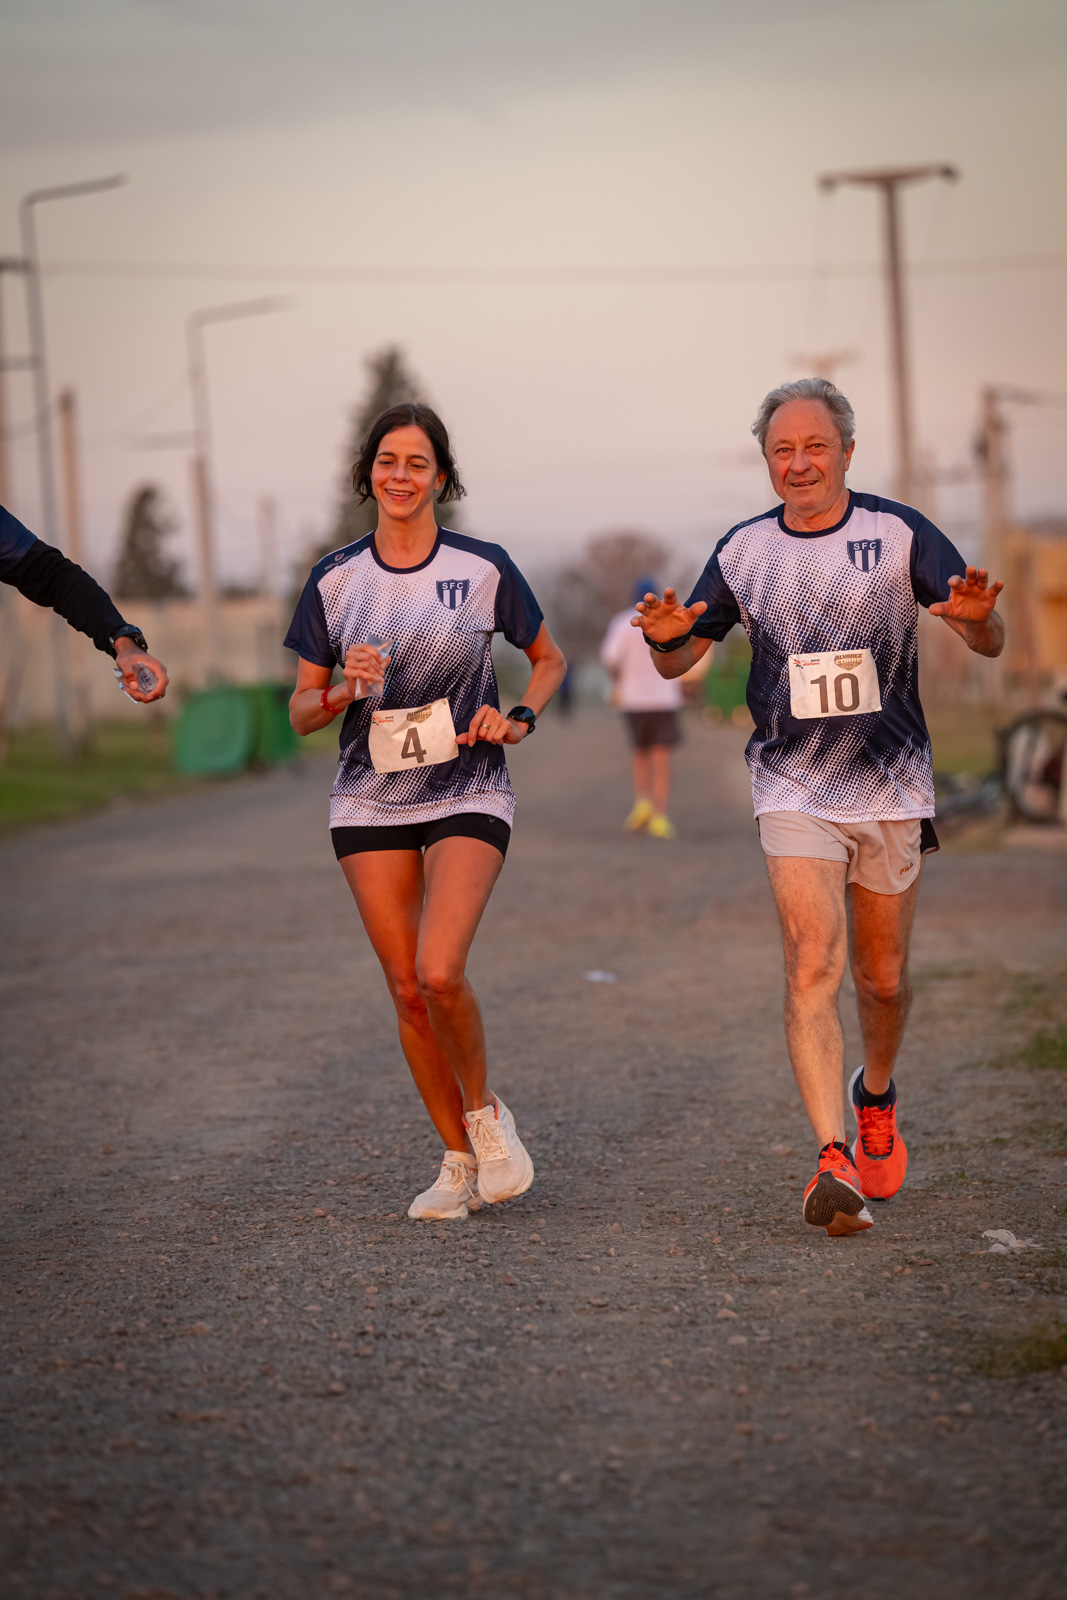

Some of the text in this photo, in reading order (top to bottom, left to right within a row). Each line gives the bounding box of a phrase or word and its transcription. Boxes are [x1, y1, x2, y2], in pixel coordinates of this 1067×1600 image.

[853, 541, 876, 550] SFC
[441, 582, 464, 590] SFC
[810, 672, 860, 714] 10
[401, 727, 427, 764] 4
